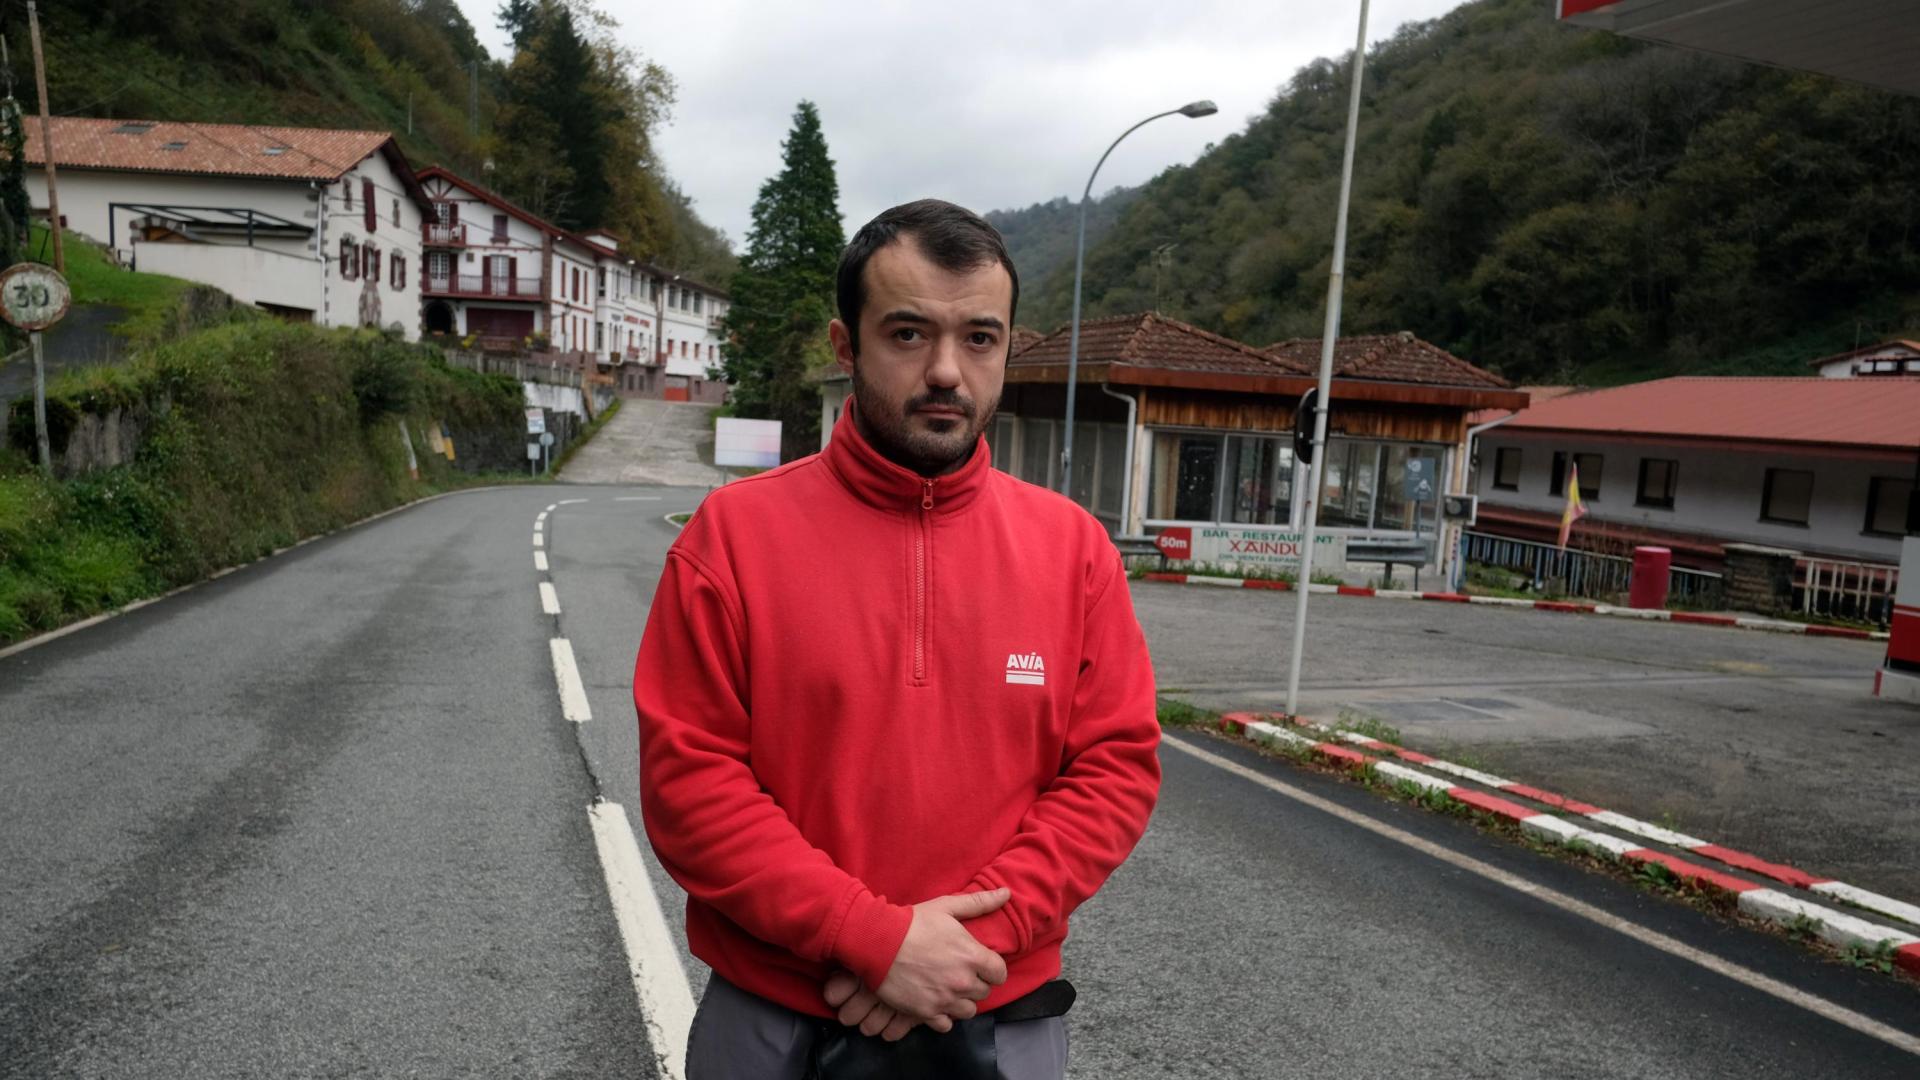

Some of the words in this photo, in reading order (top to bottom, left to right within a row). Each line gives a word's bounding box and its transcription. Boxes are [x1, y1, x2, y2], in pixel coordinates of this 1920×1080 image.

[13, 284, 49, 308] 30
[1160, 536, 1187, 548] 50m
[1202, 529, 1229, 538] BAR
[1242, 531, 1334, 544] RESTAURNT
